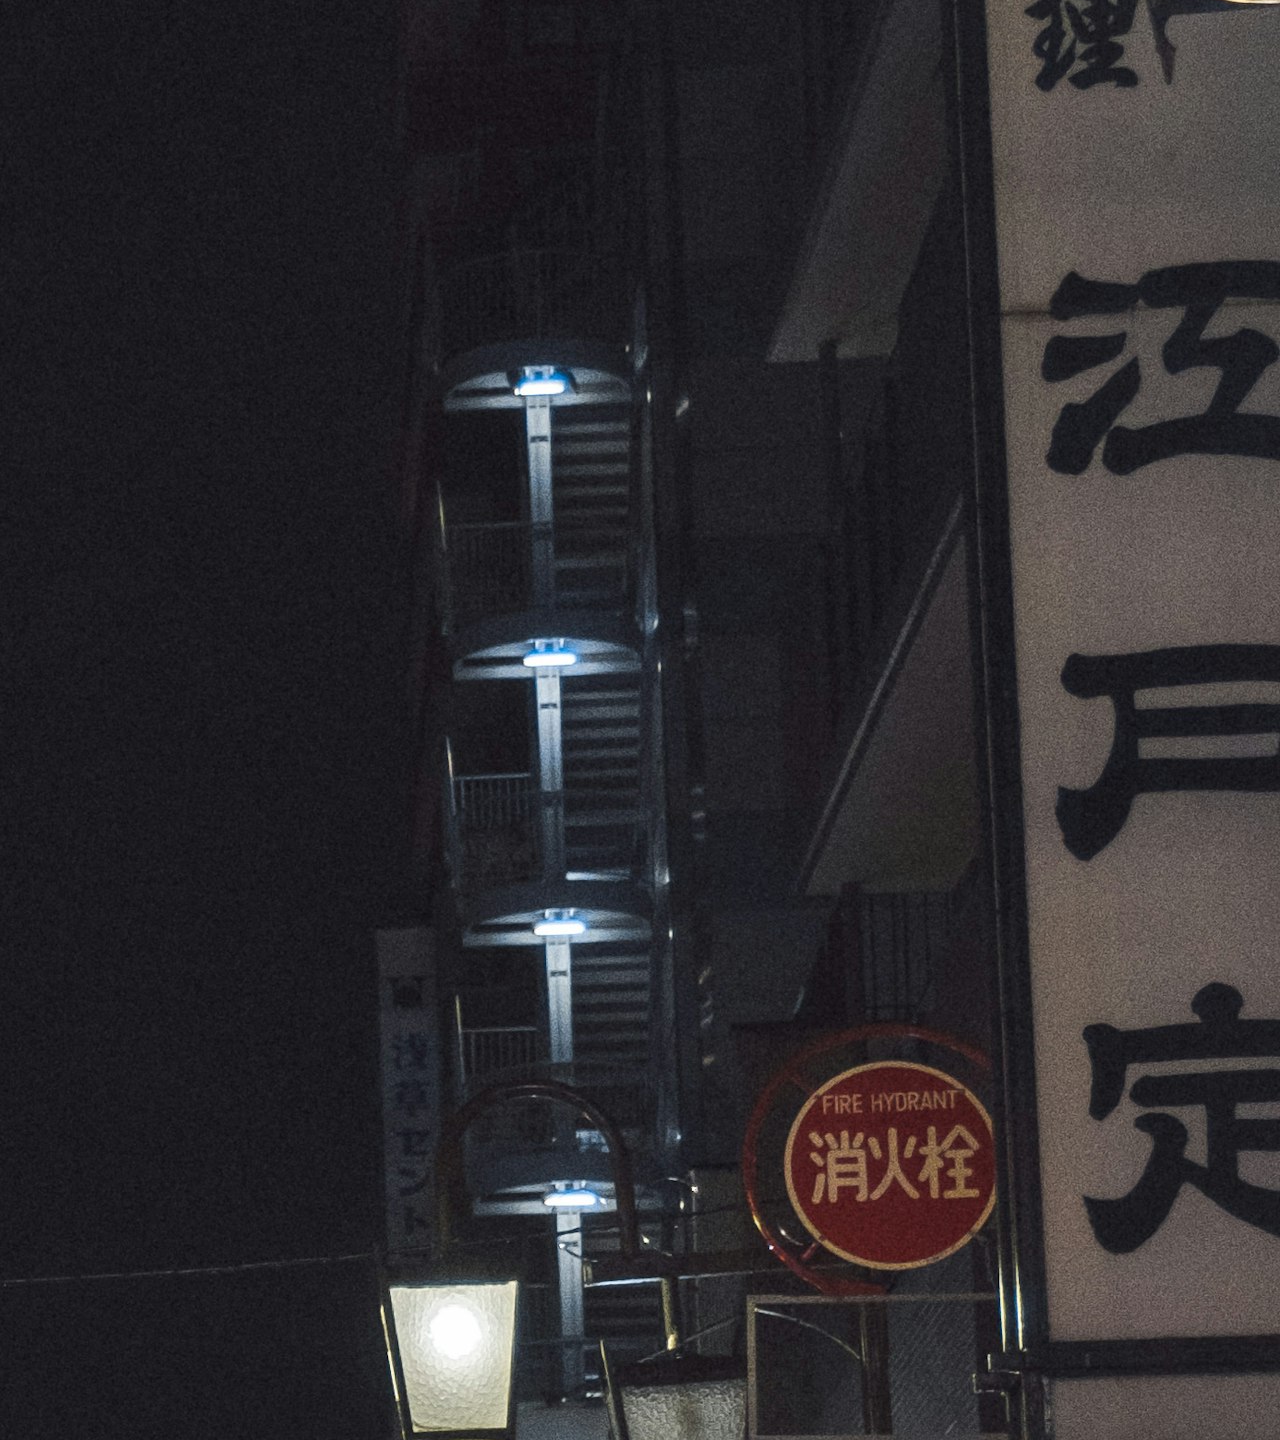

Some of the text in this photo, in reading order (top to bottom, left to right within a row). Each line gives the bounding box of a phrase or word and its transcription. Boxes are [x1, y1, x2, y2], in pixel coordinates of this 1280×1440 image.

[823, 1090, 959, 1114] FIRE HYDRANT
[809, 1124, 980, 1205] 消火栓
